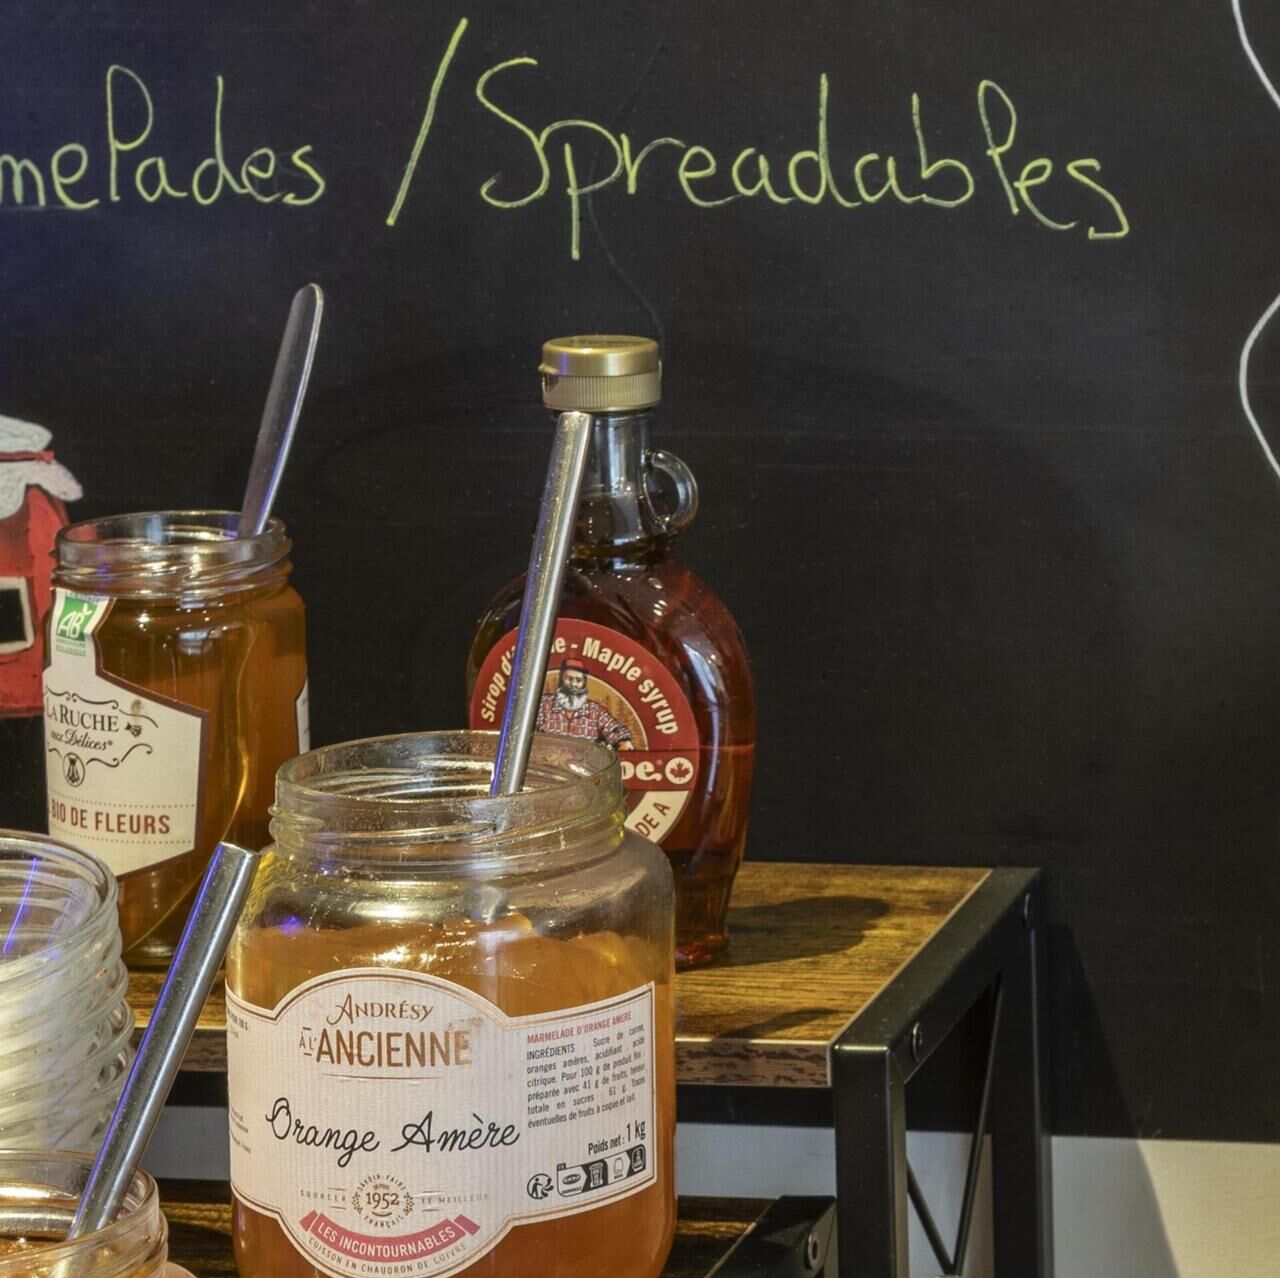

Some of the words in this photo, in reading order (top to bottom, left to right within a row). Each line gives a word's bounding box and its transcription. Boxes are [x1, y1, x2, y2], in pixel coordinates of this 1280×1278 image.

[58, 611, 85, 638] AB
[481, 672, 506, 722] Sirop
[583, 637, 643, 682] Maple
[638, 672, 680, 736] syrup
[60, 704, 119, 732] RUCHE
[51, 799, 66, 822] BIO
[71, 807, 88, 828] DE
[95, 811, 170, 834] FLEURS
[326, 993, 434, 1025] ANDRÉSY
[527, 1028, 574, 1044] MARMELADE
[577, 1019, 610, 1035] D'ORANGE
[264, 1097, 380, 1167] Orange
[391, 1110, 520, 1153] Amère
[588, 1138, 608, 1155] Poids
[610, 1134, 620, 1147] net
[627, 1123, 630, 1142] 1
[635, 1120, 645, 1140] kg
[366, 1192, 400, 1210] 1952
[308, 1238, 343, 1265] CUISSON
[346, 1260, 357, 1270] EN
[361, 1264, 413, 1275] CHAUDRON
[418, 1262, 429, 1271] DE
[433, 1244, 467, 1263] CUIVRE
[317, 1222, 336, 1242] LES
[340, 1226, 456, 1258] INCONTOURNABLES
